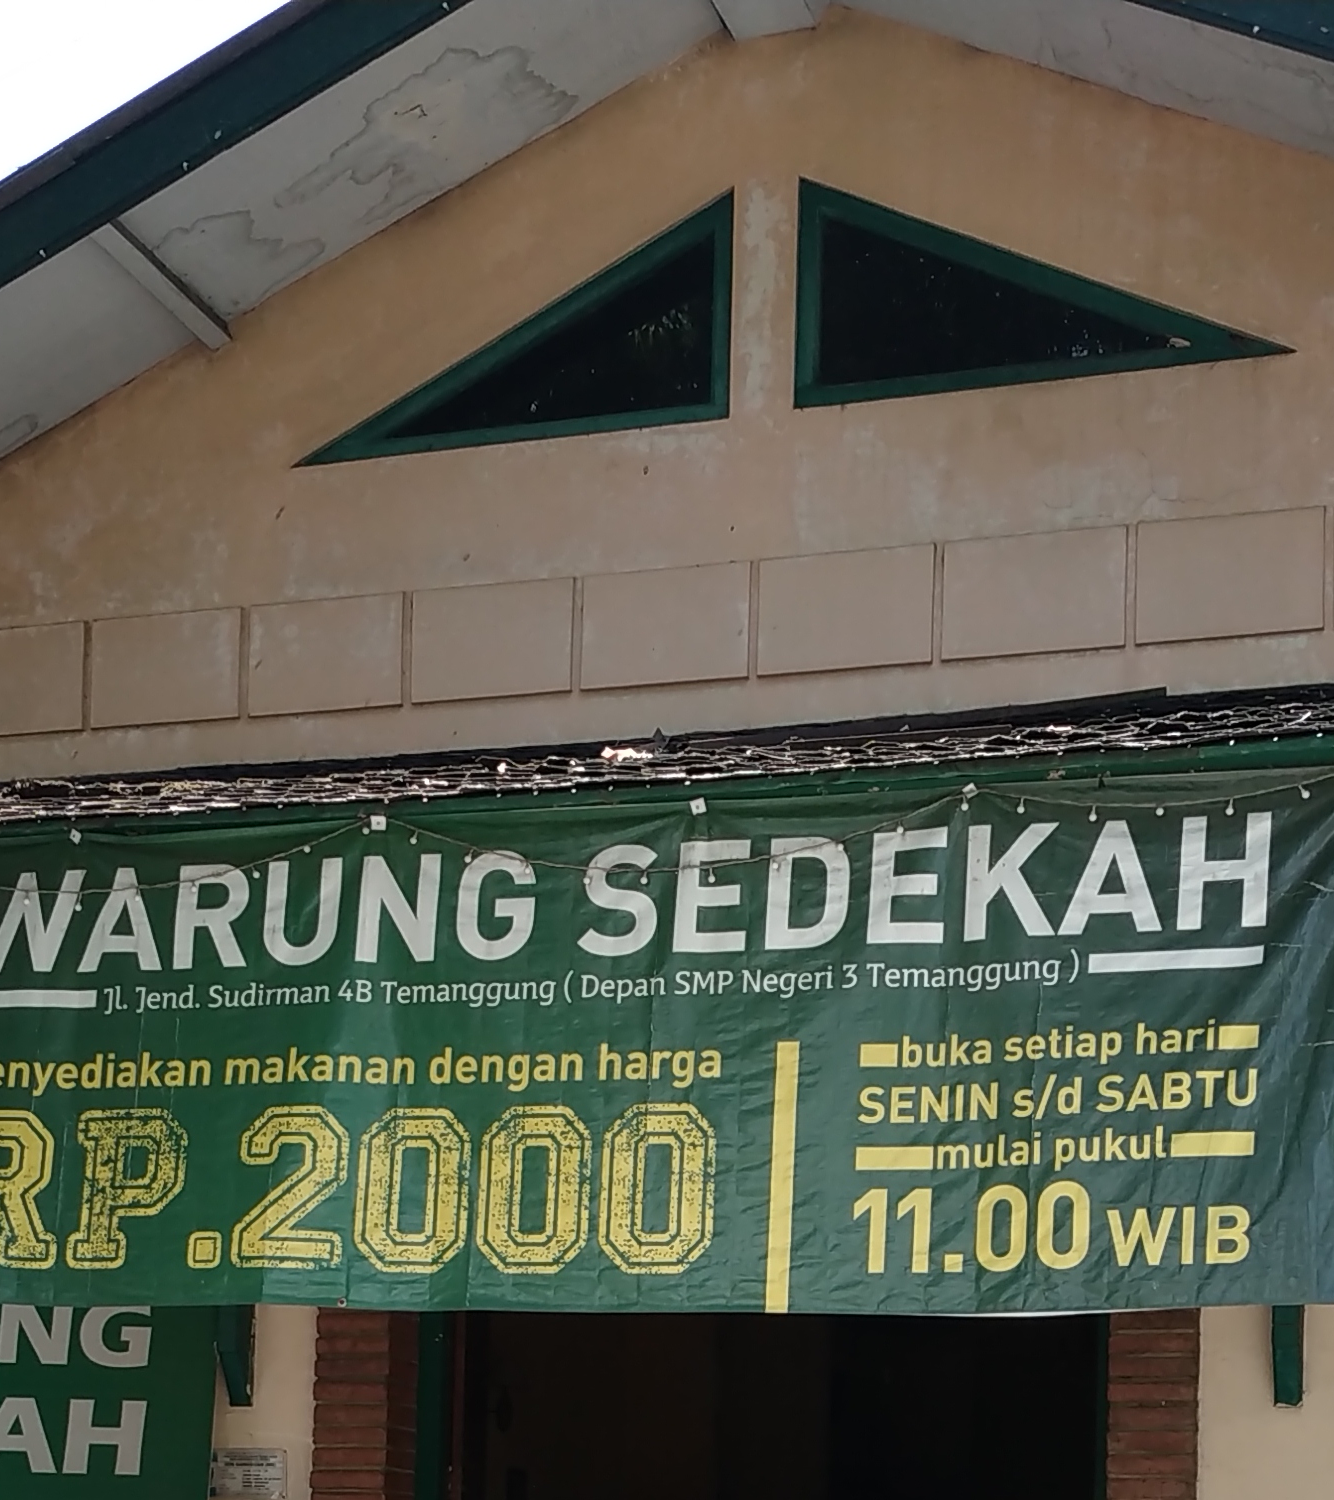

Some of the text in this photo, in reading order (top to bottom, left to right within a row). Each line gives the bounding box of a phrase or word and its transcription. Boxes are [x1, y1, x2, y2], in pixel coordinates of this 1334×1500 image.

[576, 811, 1272, 957] SEDEKAH
[103, 988, 128, 1015] Jl.
[135, 984, 201, 1014] Jend.
[208, 981, 331, 1008] Sudirman
[380, 974, 556, 1008] Temanggung
[674, 970, 734, 995] SMP
[741, 963, 835, 998] Negeri
[841, 965, 858, 989] 3
[866, 955, 1061, 991] Temanggung
[224, 1046, 416, 1085] makanan
[428, 1046, 584, 1092] dengan
[597, 1042, 723, 1088] harga
[901, 1019, 1217, 1068] buka setiap hari
[857, 1068, 1259, 1124] SENIN s/d SABTU
[937, 1126, 1167, 1172] mulai pukul
[852, 1180, 1251, 1274] 11.00 WIB
